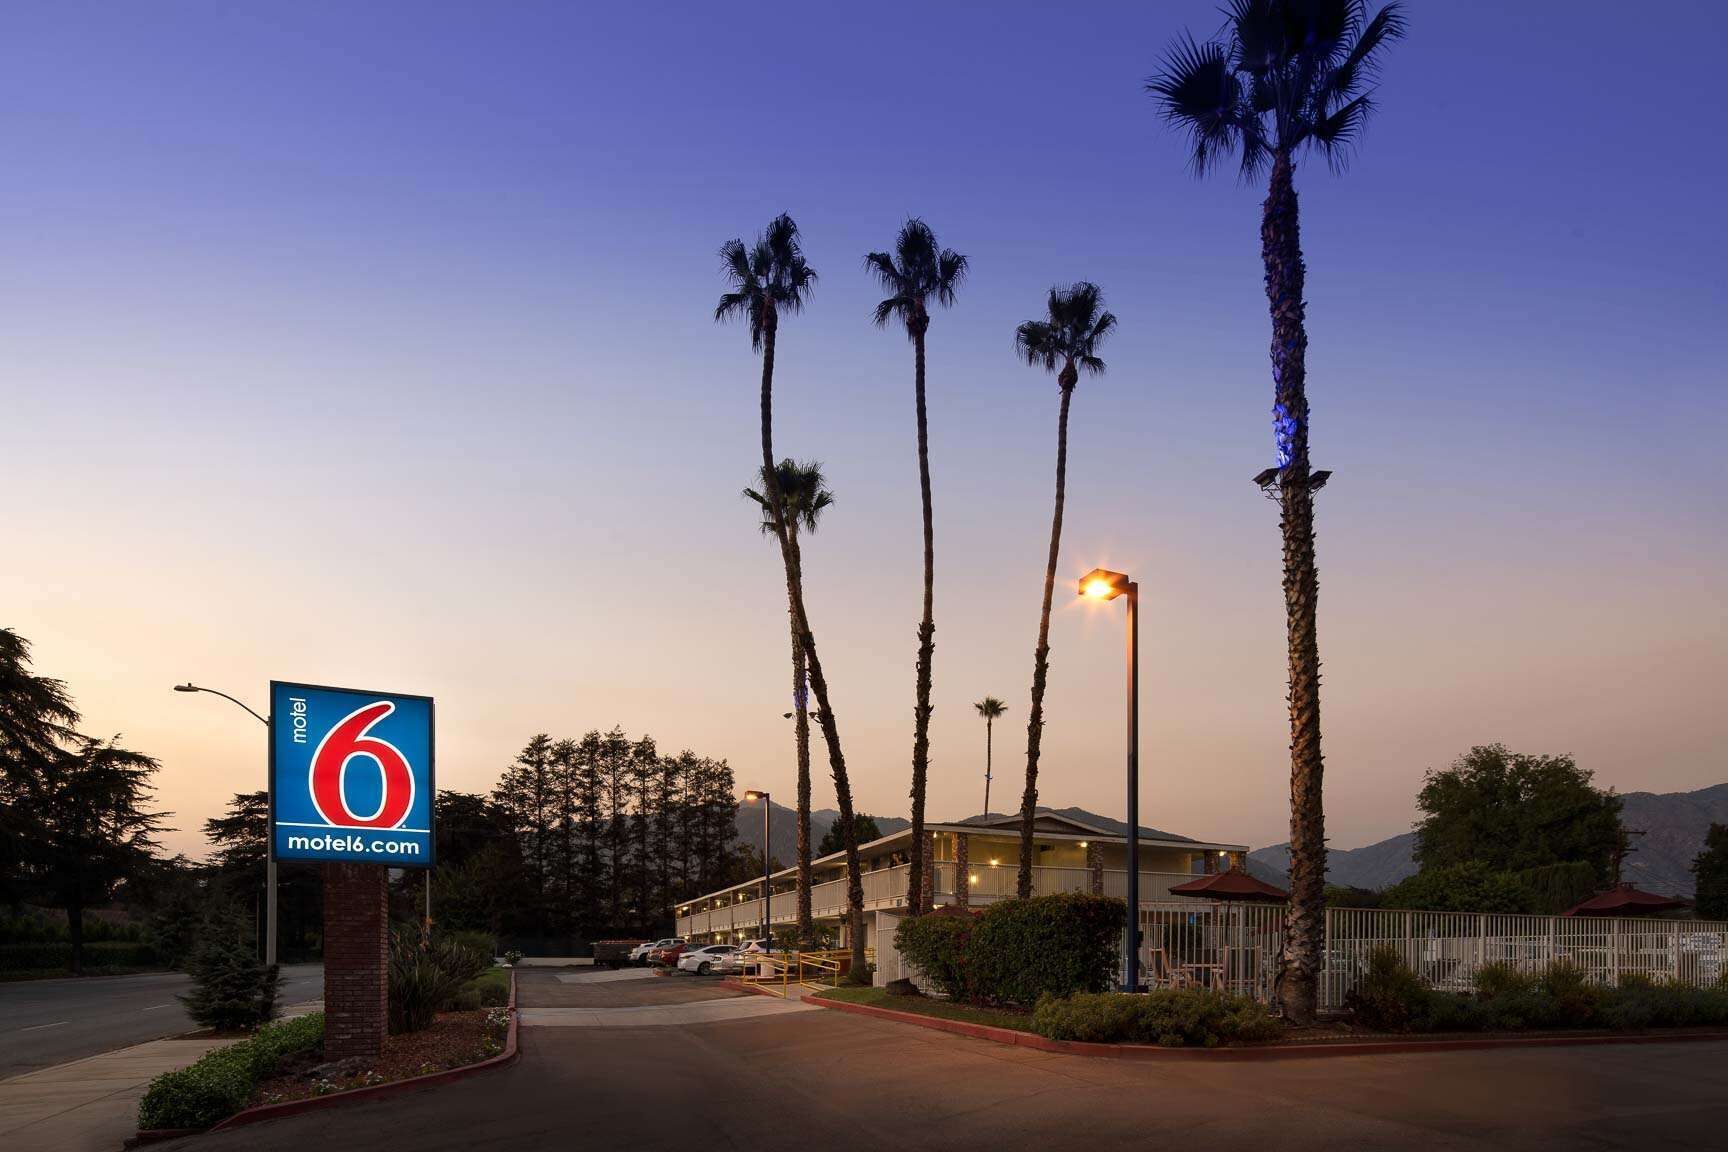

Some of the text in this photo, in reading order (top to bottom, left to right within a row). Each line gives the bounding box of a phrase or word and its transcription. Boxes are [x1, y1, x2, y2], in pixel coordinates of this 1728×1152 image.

[289, 697, 307, 744] motel
[308, 700, 416, 830] 6
[288, 834, 420, 855] motel6.com
